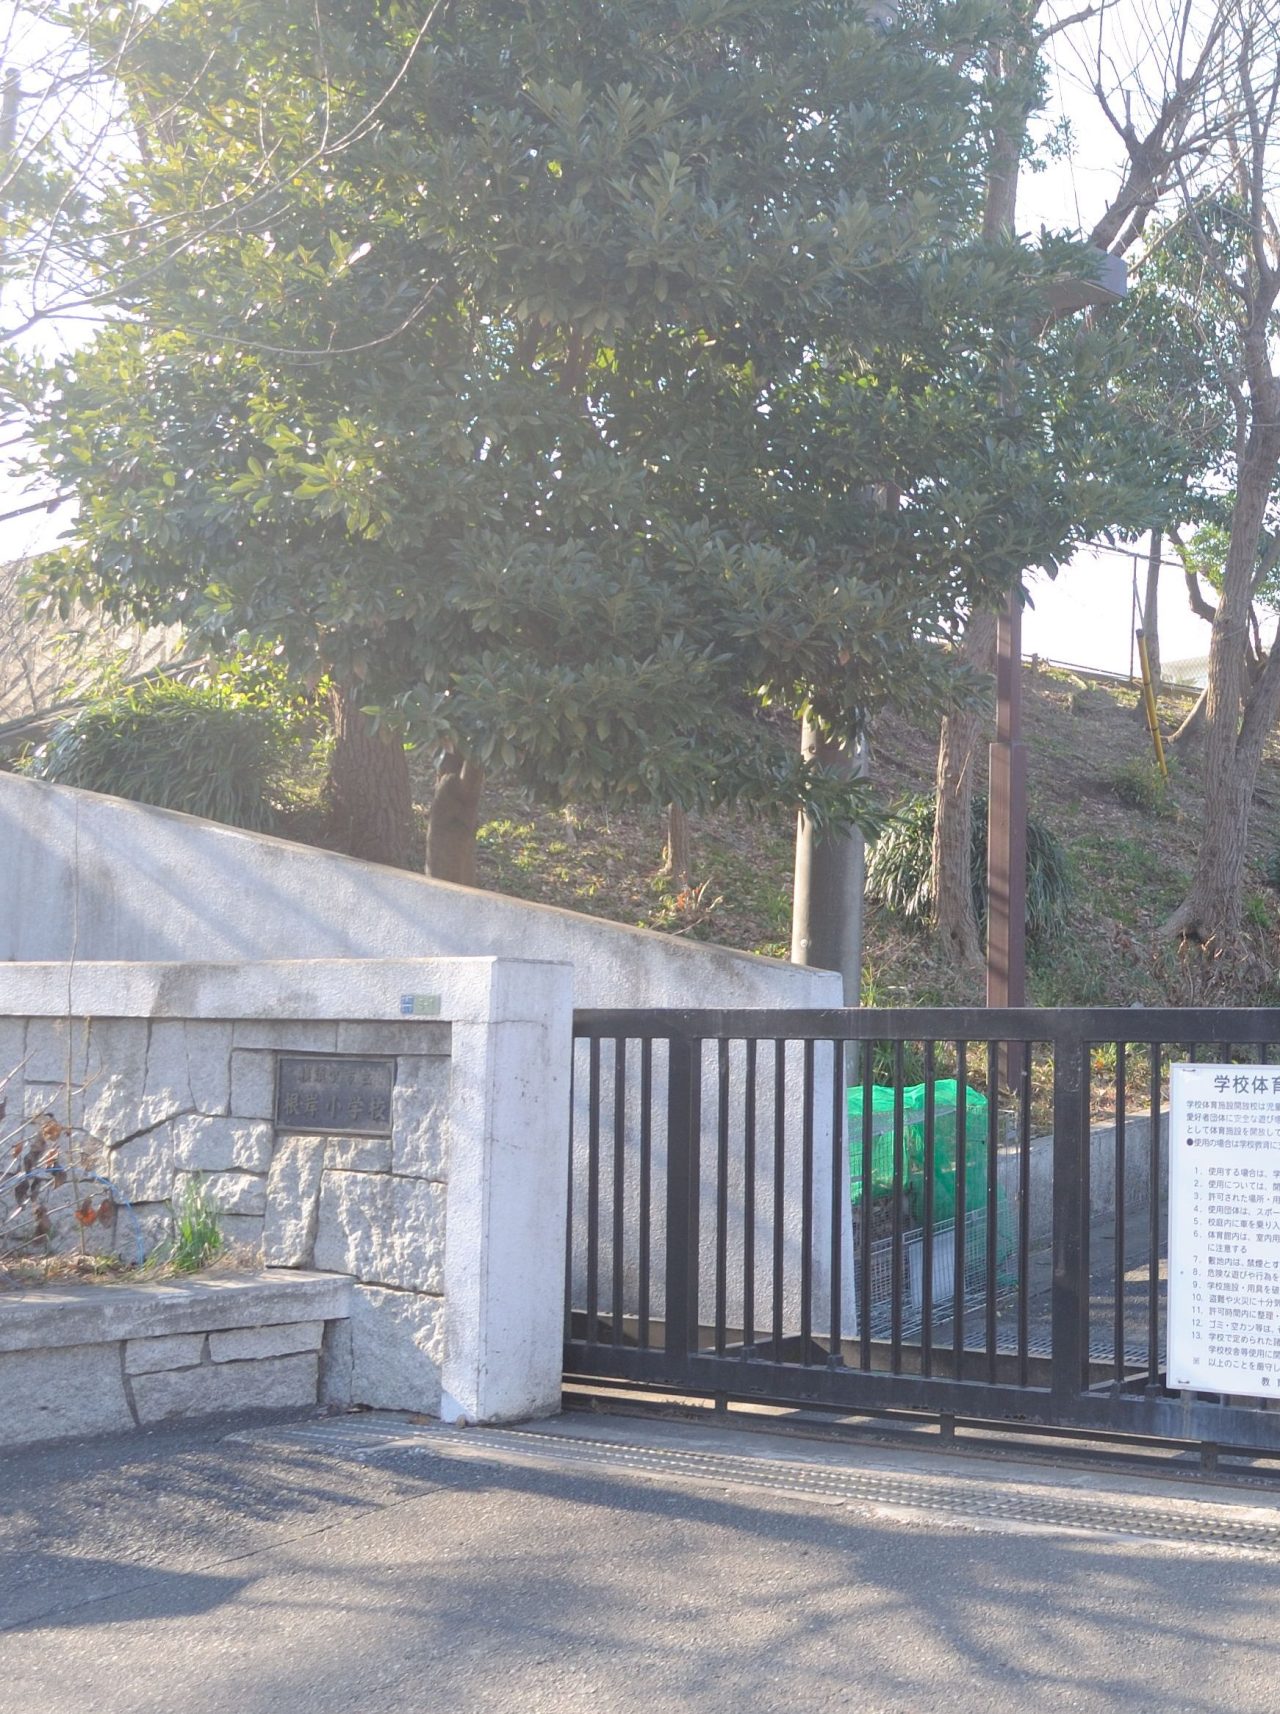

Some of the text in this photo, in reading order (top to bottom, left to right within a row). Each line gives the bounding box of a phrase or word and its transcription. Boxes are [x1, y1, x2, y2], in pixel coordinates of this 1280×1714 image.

[1208, 1244, 1247, 1253] に注意する
